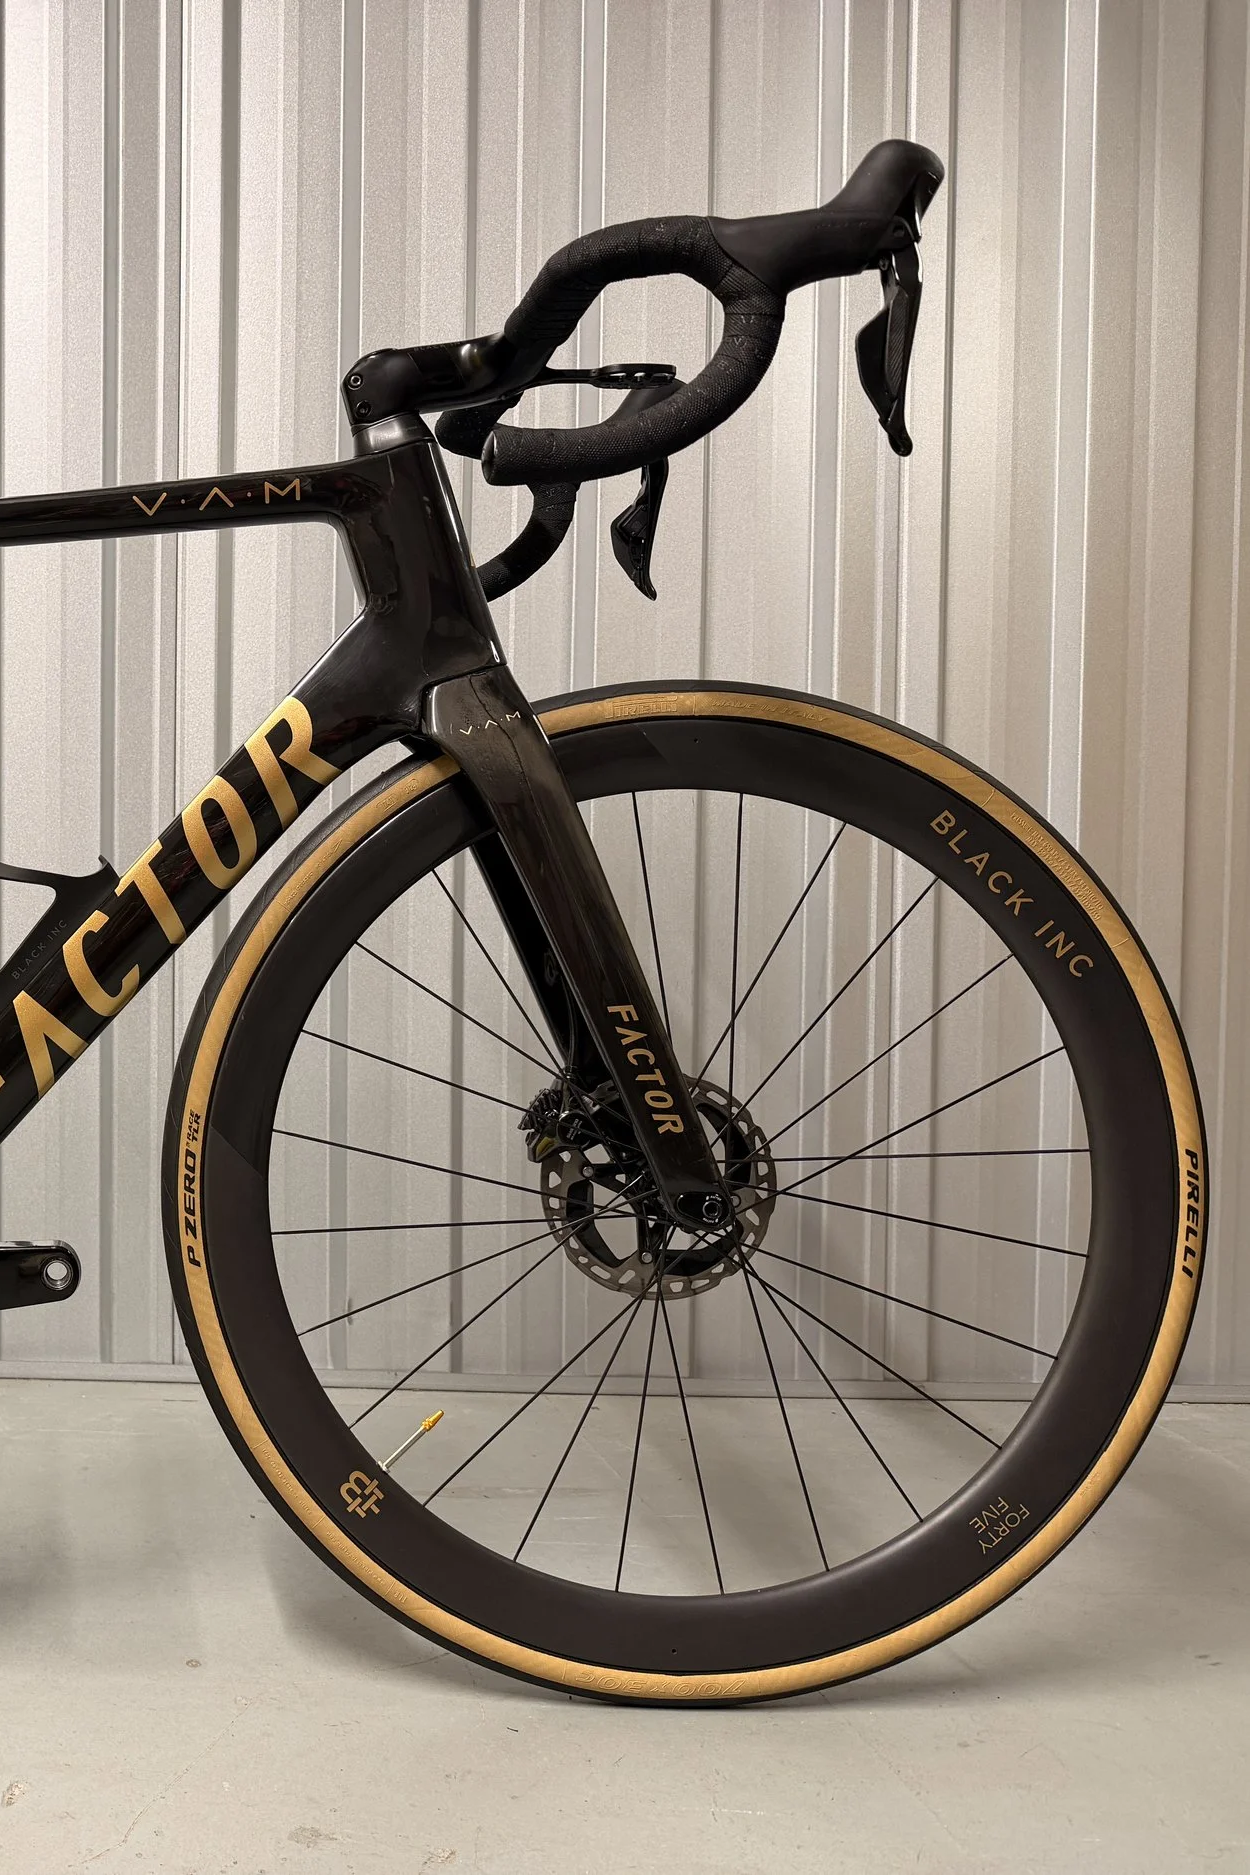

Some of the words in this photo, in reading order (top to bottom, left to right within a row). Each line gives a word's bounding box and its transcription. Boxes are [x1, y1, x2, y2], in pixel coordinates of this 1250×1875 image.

[929, 809, 1035, 916] BLACK
[1034, 919, 1094, 978] INC
[11, 942, 47, 980] BLACK
[47, 920, 67, 940] INC
[606, 1004, 685, 1135] FACTOR
[191, 1113, 201, 1143] TLR
[184, 1148, 196, 1239] ZERO
[1182, 1148, 1199, 1279] PIRELLI
[188, 1245, 201, 1267] P
[969, 1496, 1009, 1534] FIVE
[978, 1503, 1030, 1554] FORTY
